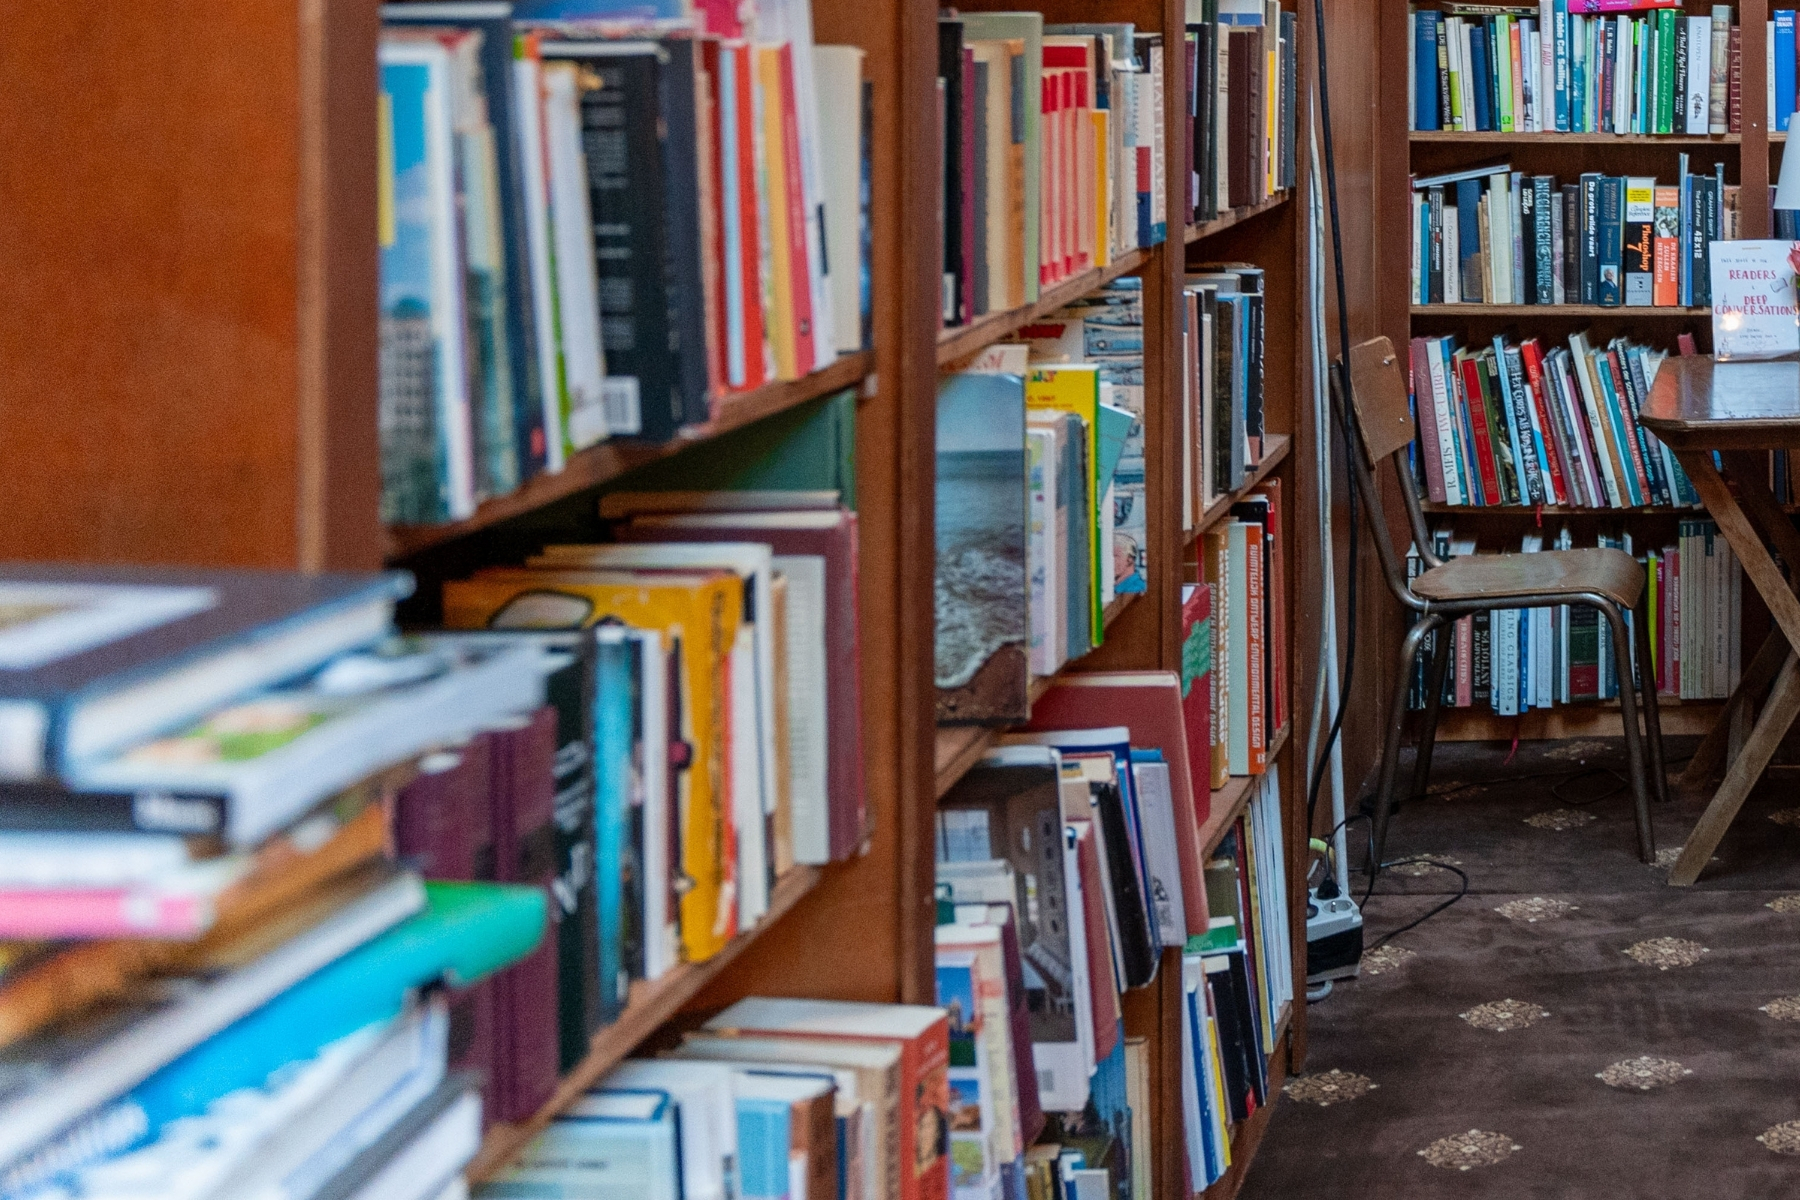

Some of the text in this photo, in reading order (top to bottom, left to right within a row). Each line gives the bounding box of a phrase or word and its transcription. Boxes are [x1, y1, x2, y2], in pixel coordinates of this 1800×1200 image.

[1437, 35, 1446, 45] DE
[1555, 12, 1566, 91] Hobie Cat Sailing
[1678, 35, 1687, 48] Bed
[1542, 50, 1552, 66] AMO
[1678, 55, 1687, 67] Red
[1678, 68, 1687, 91] Flowers
[1153, 52, 1164, 220] WHAT IT TAKES
[1536, 181, 1551, 245] NICCI FRENCH
[1586, 181, 1597, 257] De grote wilde vaart
[1729, 193, 1738, 239] Irving Wallace
[1627, 241, 1641, 253] 7
[1639, 224, 1652, 272] Photoshop
[1693, 230, 1703, 259] 42x12
[1729, 269, 1777, 280] READERS
[1714, 305, 1797, 316] CONVERSATIONS
[1744, 294, 1768, 305] DEEP
[1616, 343, 1627, 370] Meesters
[1513, 389, 1526, 416] CORPS
[1624, 382, 1640, 421] Schilderkunst
[1432, 362, 1455, 475] MEIS IWC-UHREN
[1619, 395, 1645, 479] THE DECORATIVE PAINTER
[1636, 426, 1649, 453] Vincent
[1642, 453, 1651, 464] van
[1644, 465, 1655, 482] Gogh
[1249, 544, 1261, 748] RUIMTELIJK ONTWERP ENVIRONMENTAL DESIGN
[1506, 642, 1515, 702] CLASSICS
